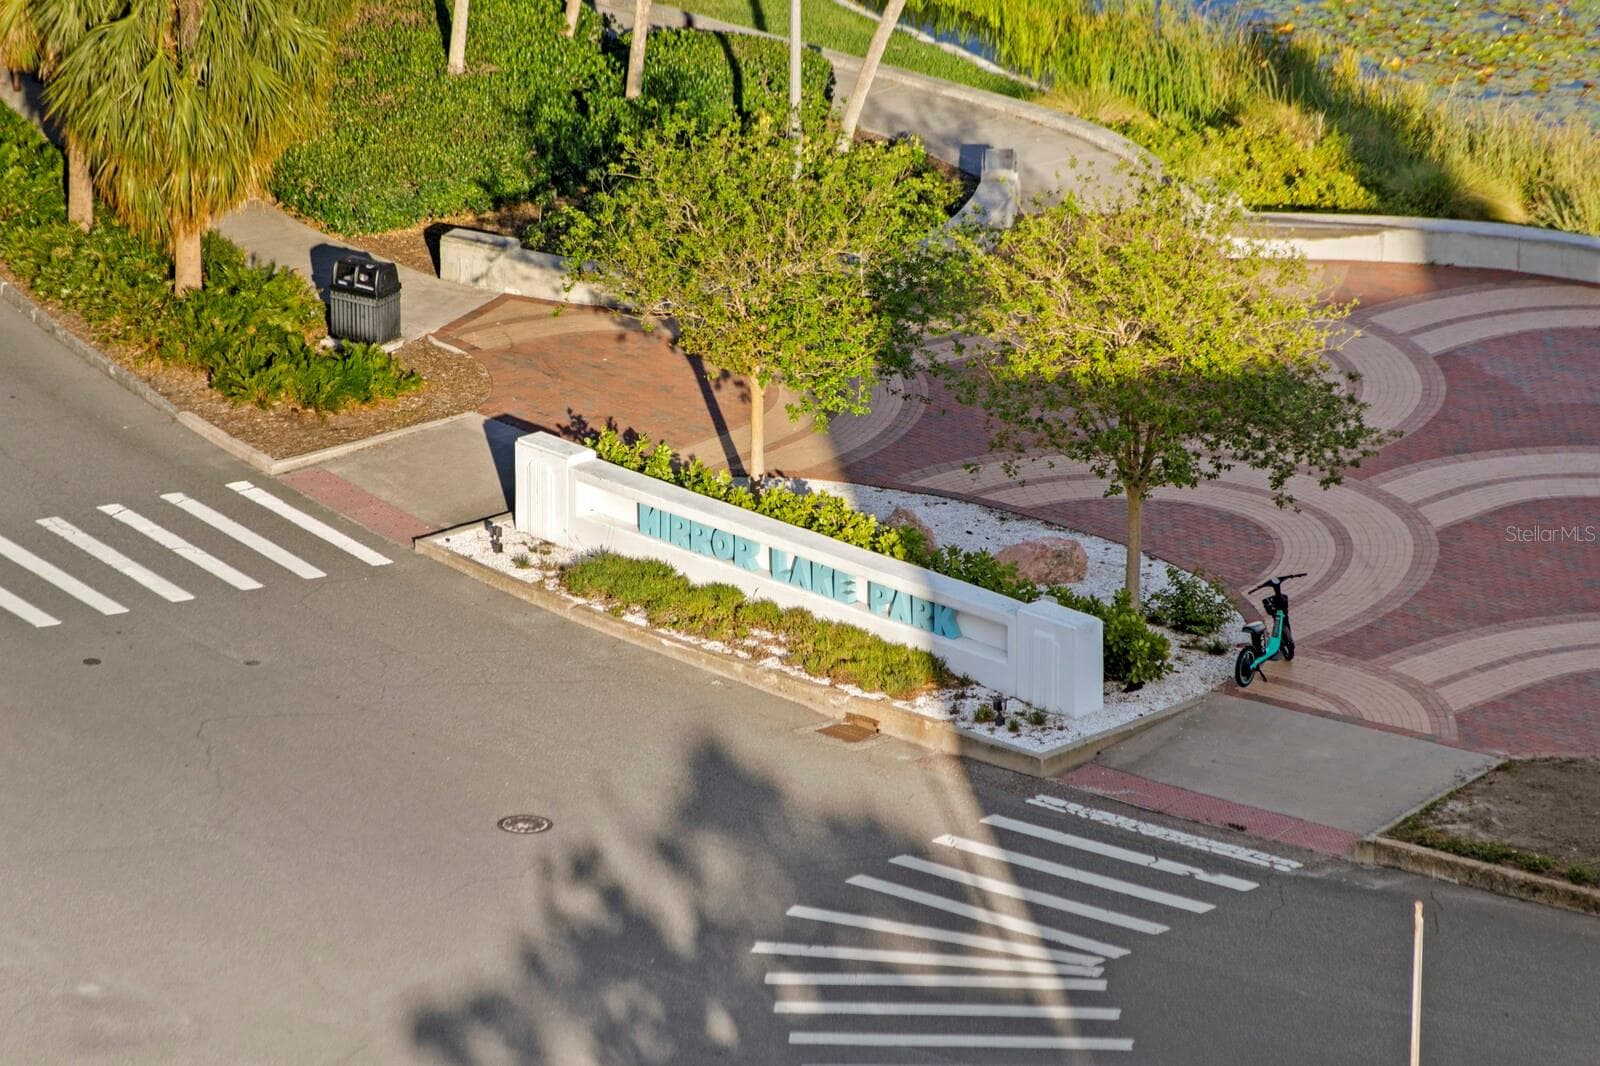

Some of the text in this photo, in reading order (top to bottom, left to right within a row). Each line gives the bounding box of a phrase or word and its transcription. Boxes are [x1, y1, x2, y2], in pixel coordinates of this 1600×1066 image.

[637, 502, 961, 640] MIRROR LAKE PARK
